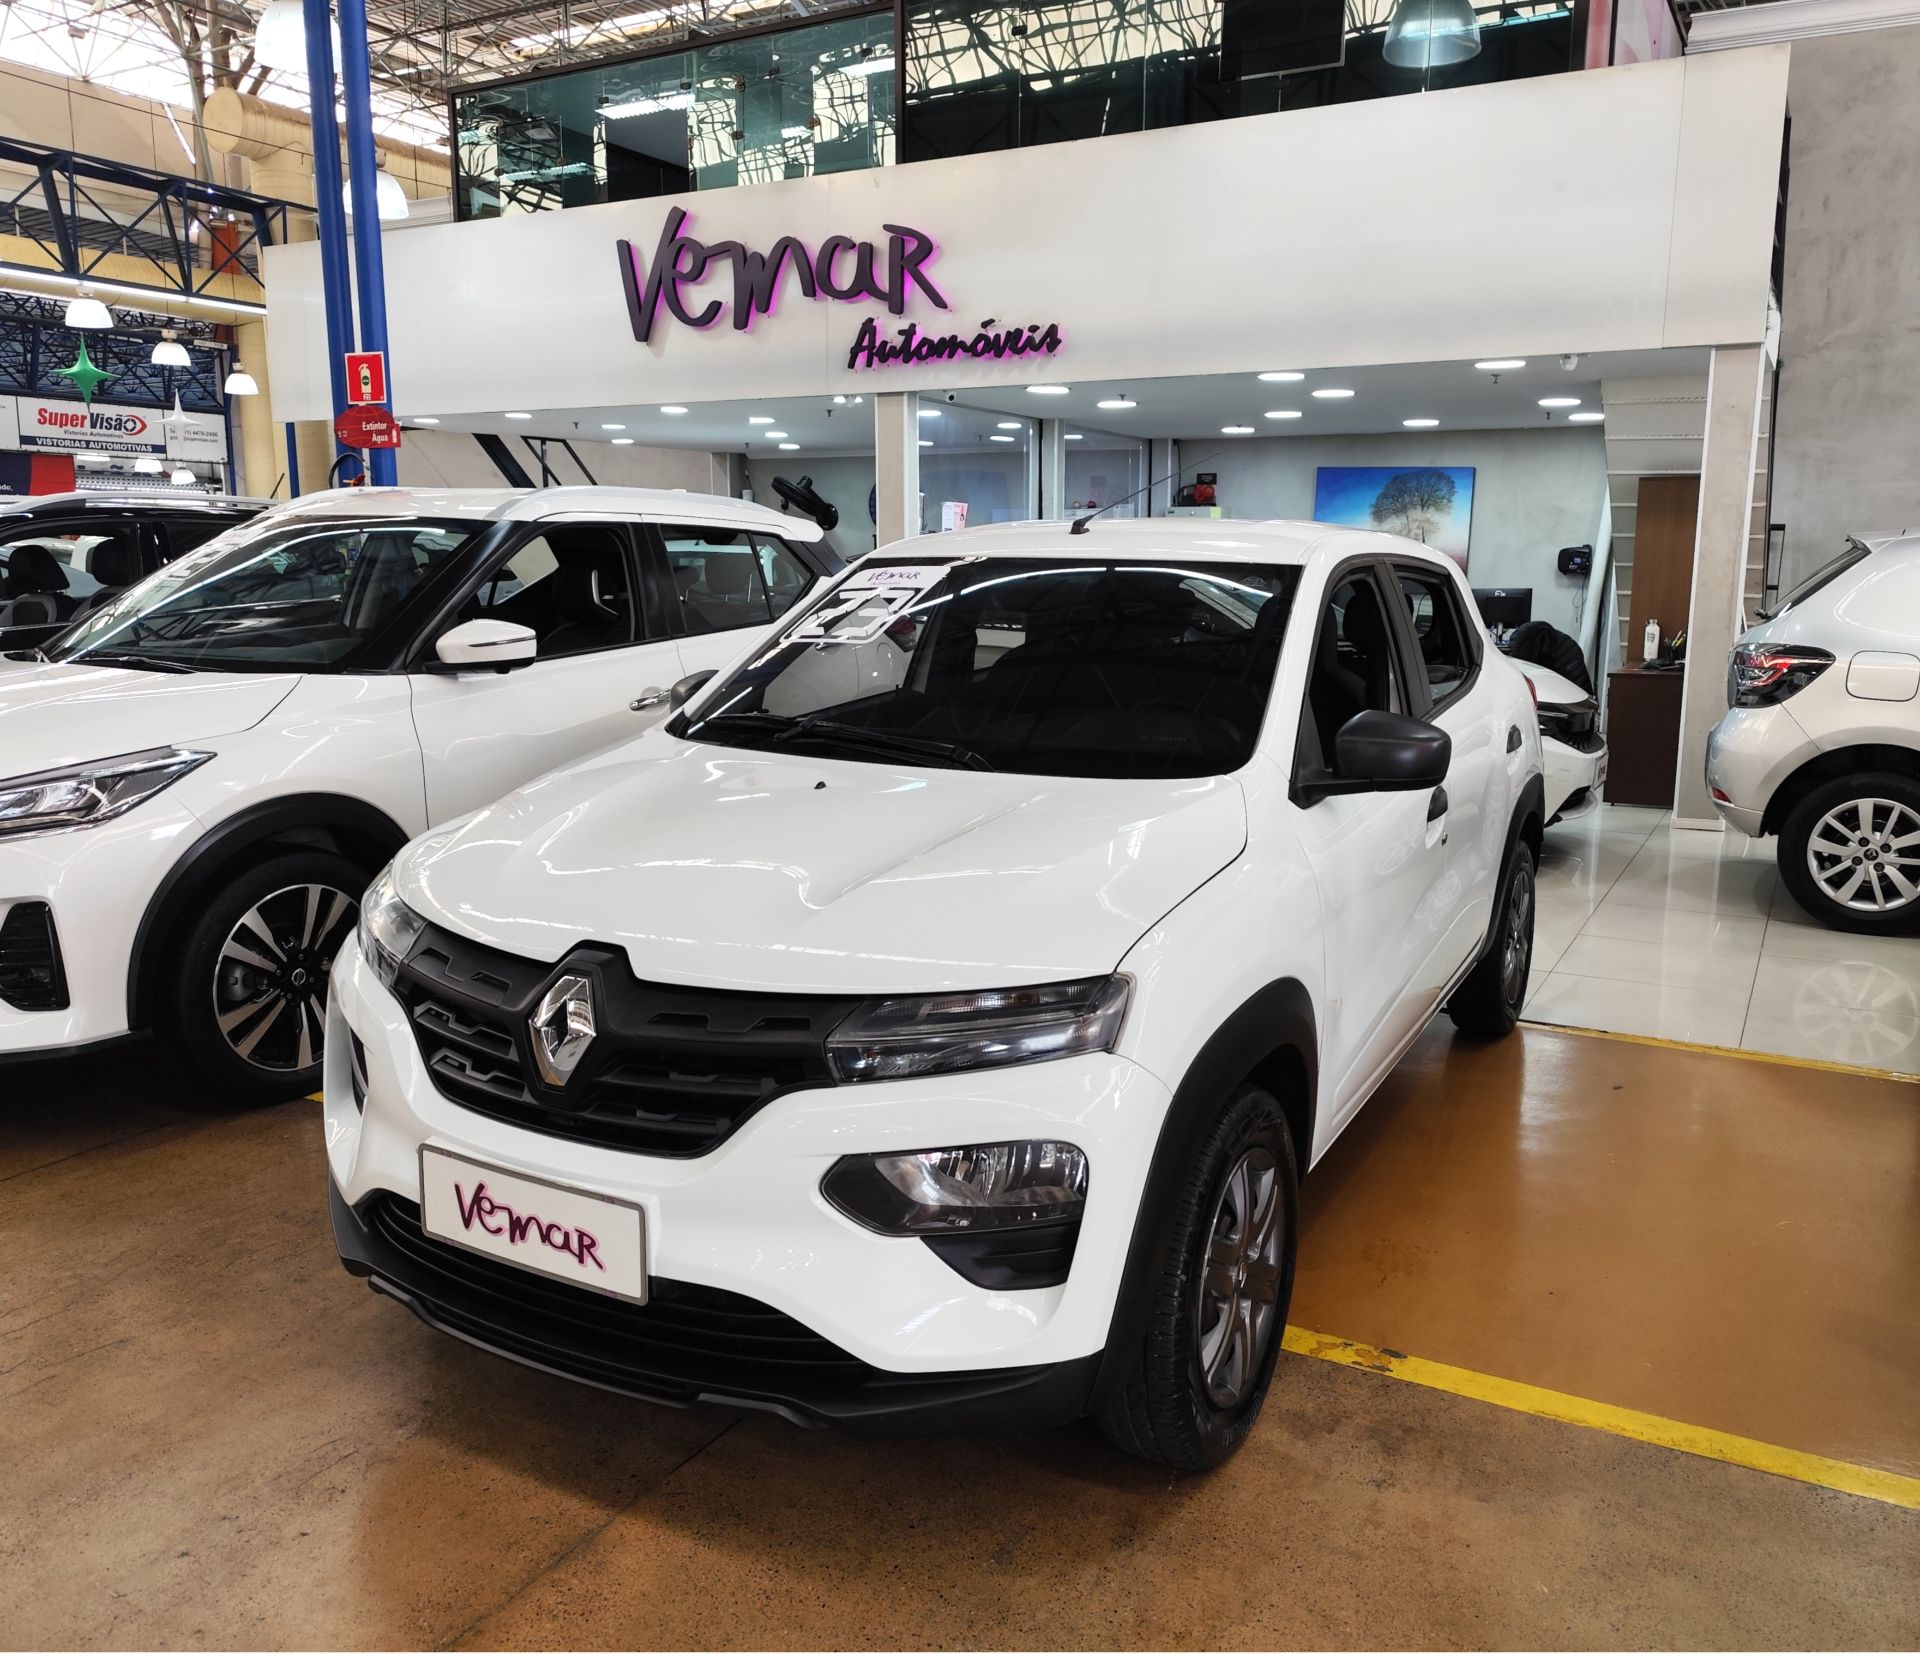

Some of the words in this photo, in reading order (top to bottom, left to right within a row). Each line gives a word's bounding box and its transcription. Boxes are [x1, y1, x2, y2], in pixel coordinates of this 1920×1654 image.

[847, 318, 1062, 370] Automóveis
[38, 408, 87, 428] Super
[362, 421, 387, 431] Extintor
[64, 429, 88, 437] Vistorias
[89, 431, 124, 439] Automotivas
[36, 438, 86, 449] VISTORIAS
[89, 441, 152, 452] AUTOMOTIVAS
